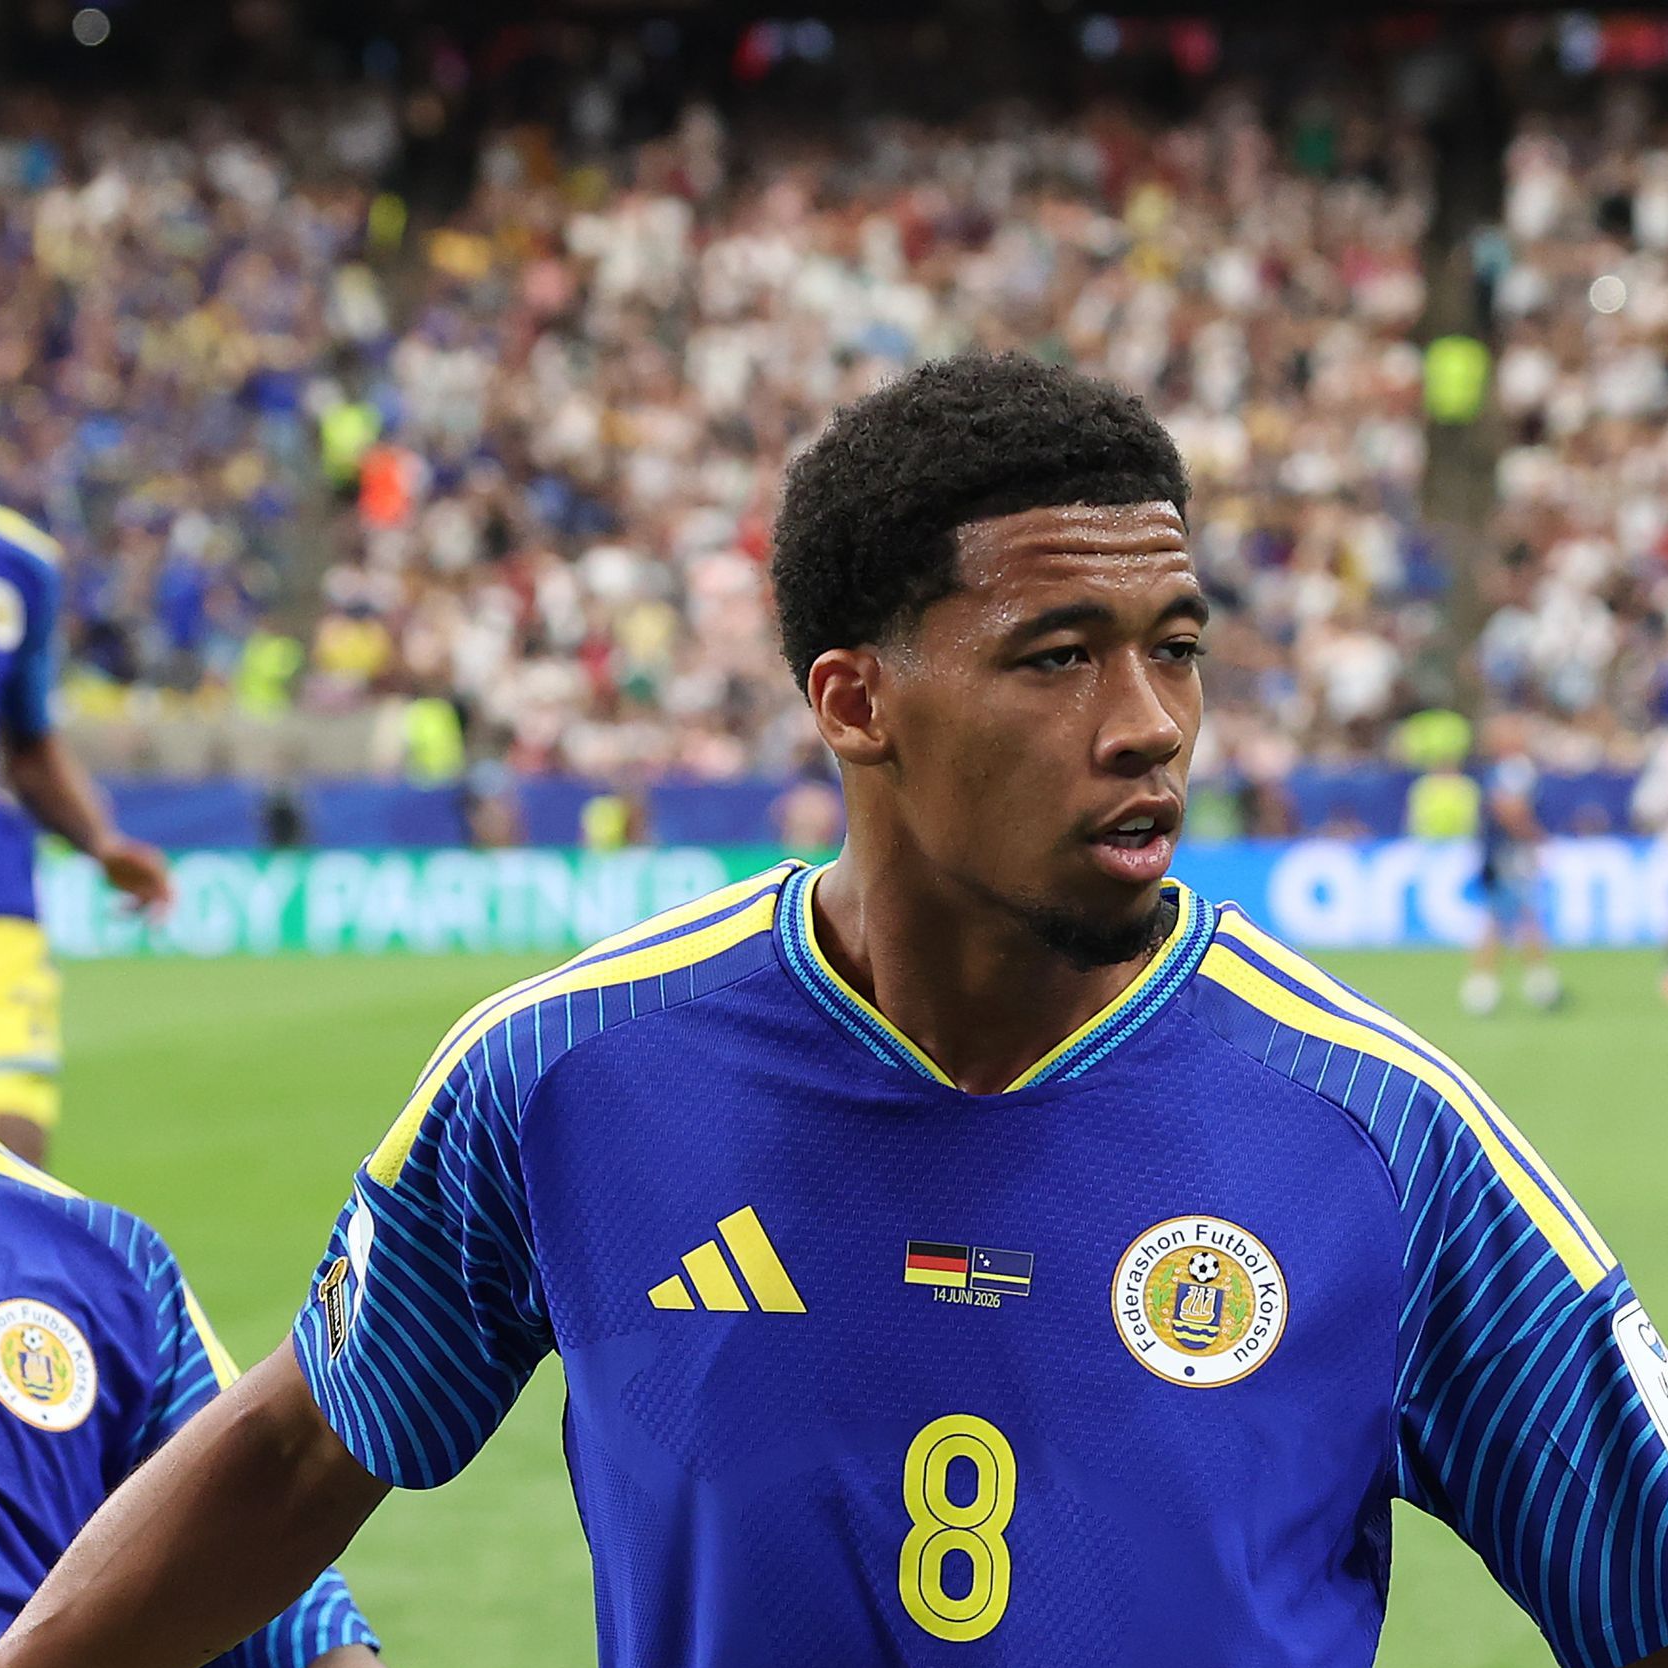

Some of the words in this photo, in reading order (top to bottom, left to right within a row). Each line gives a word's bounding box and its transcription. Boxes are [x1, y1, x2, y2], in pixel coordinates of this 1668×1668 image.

[332, 1285, 342, 1339] DEBUT
[933, 1287, 947, 1302] 14
[947, 1289, 973, 1305] JUNI
[974, 1291, 1001, 1309] 2026
[1123, 1230, 1185, 1352] Federashon
[1195, 1224, 1268, 1275] Futbòl
[1233, 1282, 1279, 1363] Kòrsou
[898, 1413, 1018, 1643] 8
